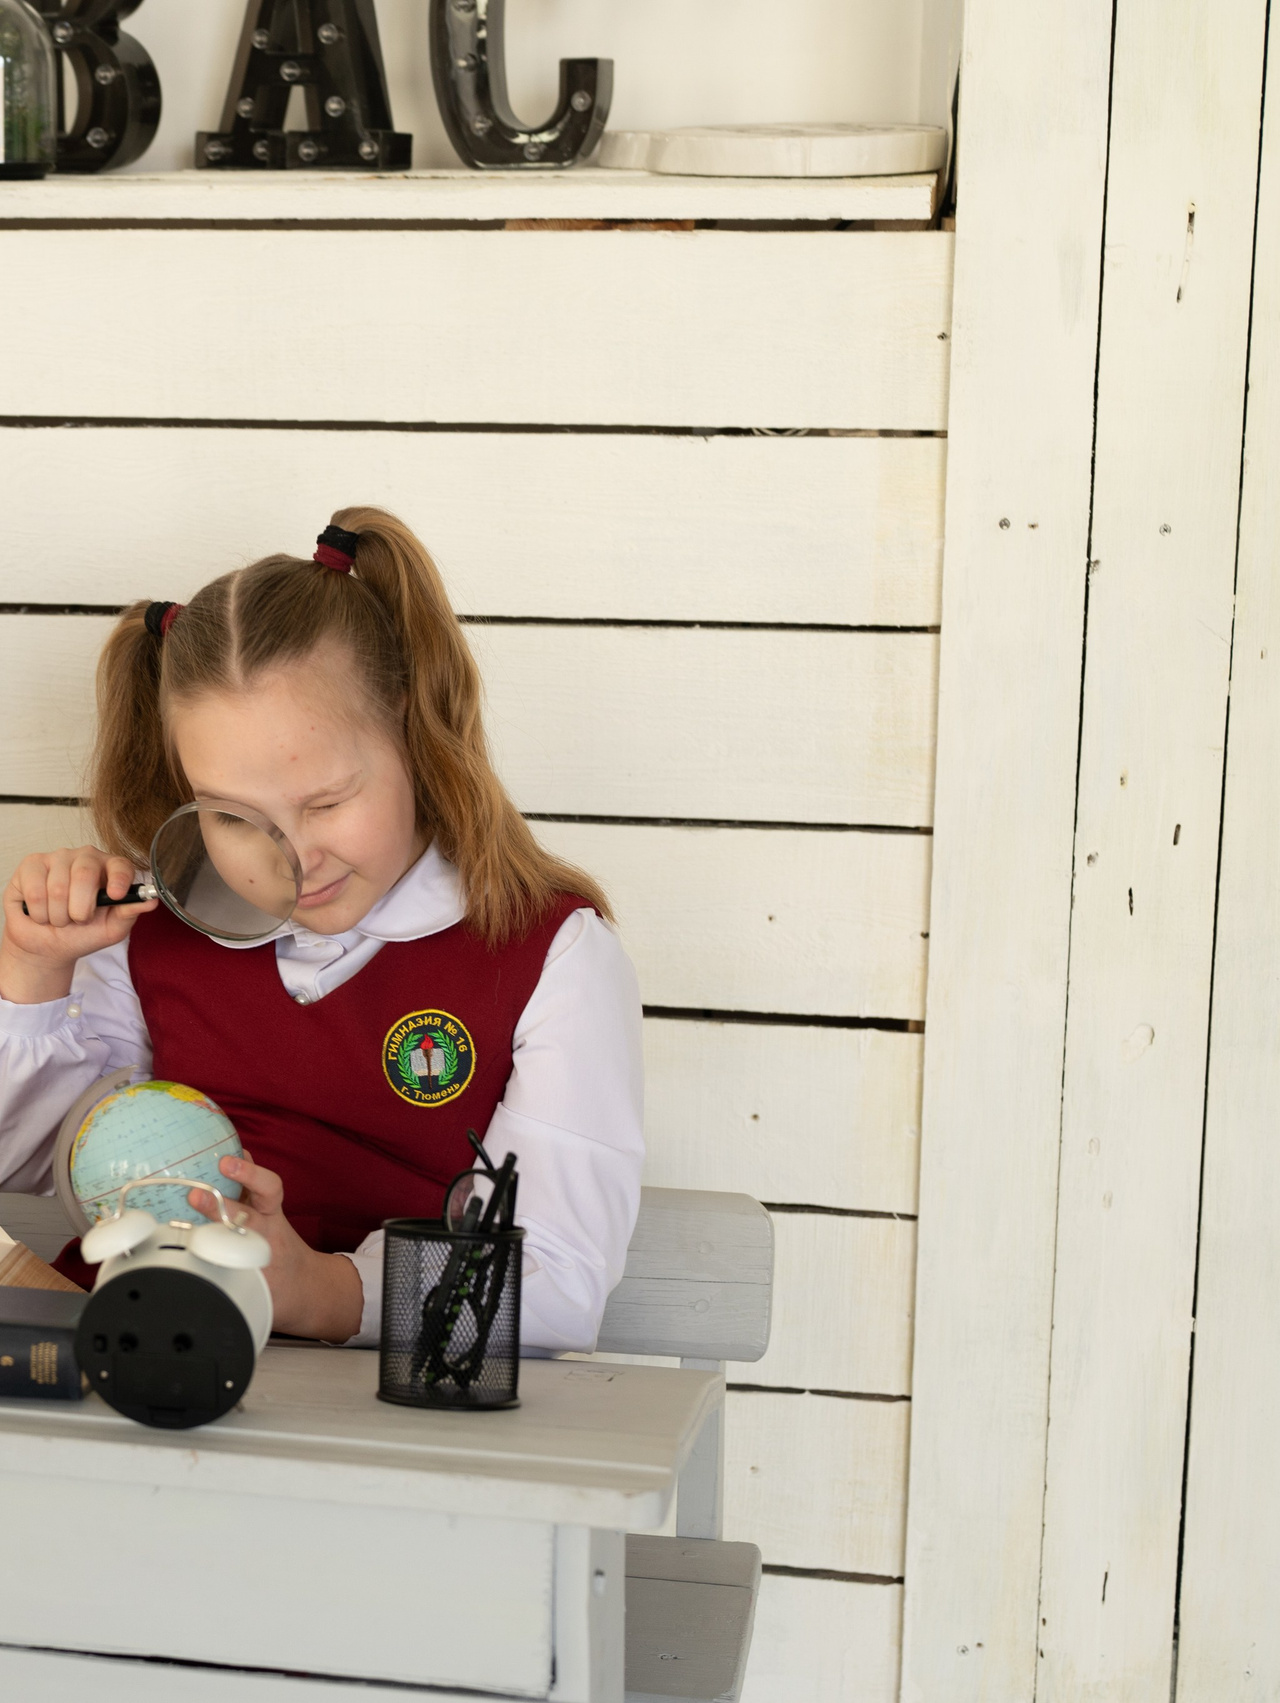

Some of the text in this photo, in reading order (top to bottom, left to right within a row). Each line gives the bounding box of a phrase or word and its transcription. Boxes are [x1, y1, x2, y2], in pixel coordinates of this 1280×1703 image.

[388, 1016, 468, 1060] ГИМНАЗИЯ № 16
[414, 1083, 460, 1101] Тюмень
